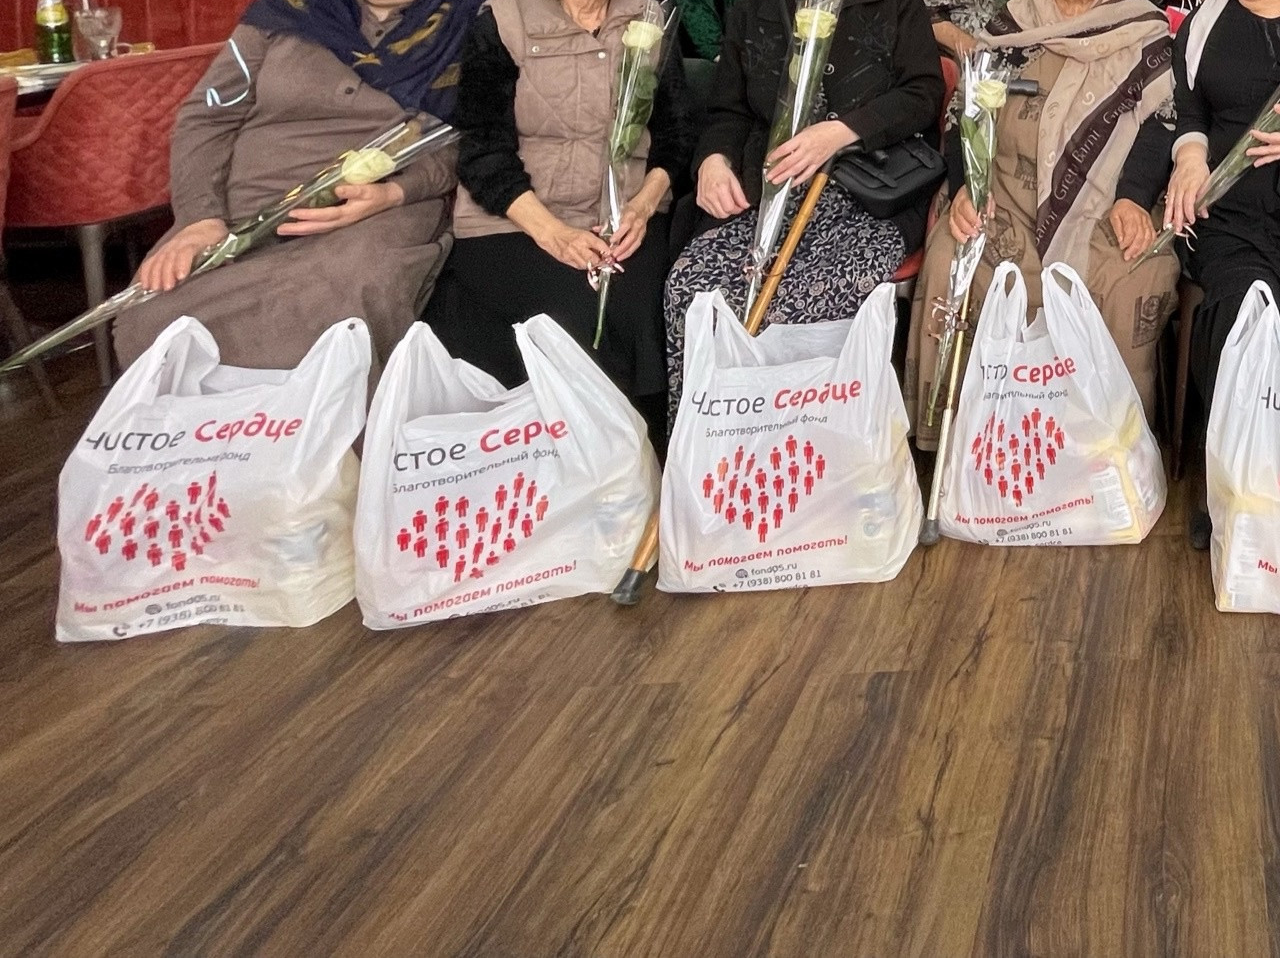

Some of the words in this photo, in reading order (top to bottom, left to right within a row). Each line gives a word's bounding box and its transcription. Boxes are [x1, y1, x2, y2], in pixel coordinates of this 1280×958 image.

[194, 412, 303, 443] Сердце
[394, 443, 467, 471] стое
[708, 550, 773, 567] помогаем
[776, 535, 848, 556] помогать!
[775, 574, 793, 584] 800
[795, 572, 807, 581] 81
[810, 570, 821, 579] 81
[1258, 559, 1278, 573] Мы
[413, 586, 491, 618] помогаем
[496, 559, 577, 594] помогать!
